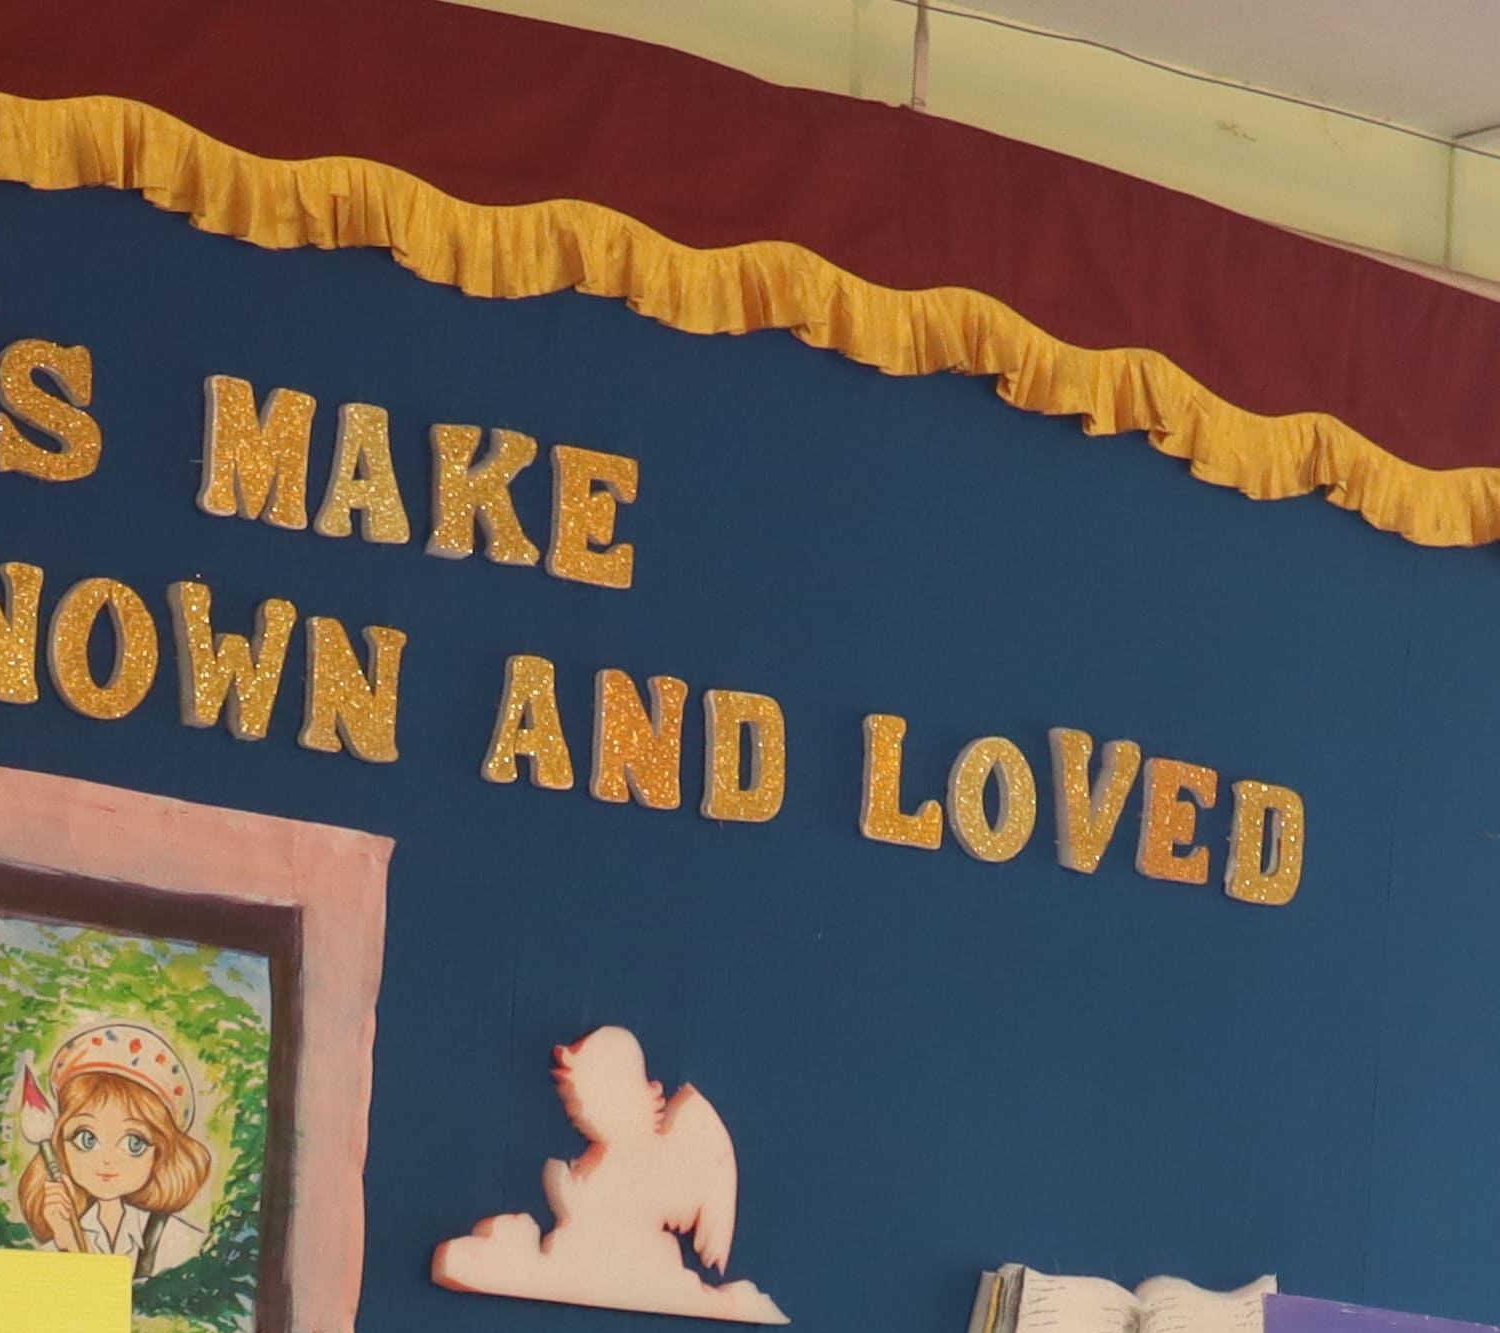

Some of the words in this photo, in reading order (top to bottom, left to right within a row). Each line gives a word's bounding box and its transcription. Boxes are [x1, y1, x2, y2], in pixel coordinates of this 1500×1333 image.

[197, 374, 640, 590] MAKE
[481, 653, 788, 824] AND
[858, 713, 1306, 906] LOVED
